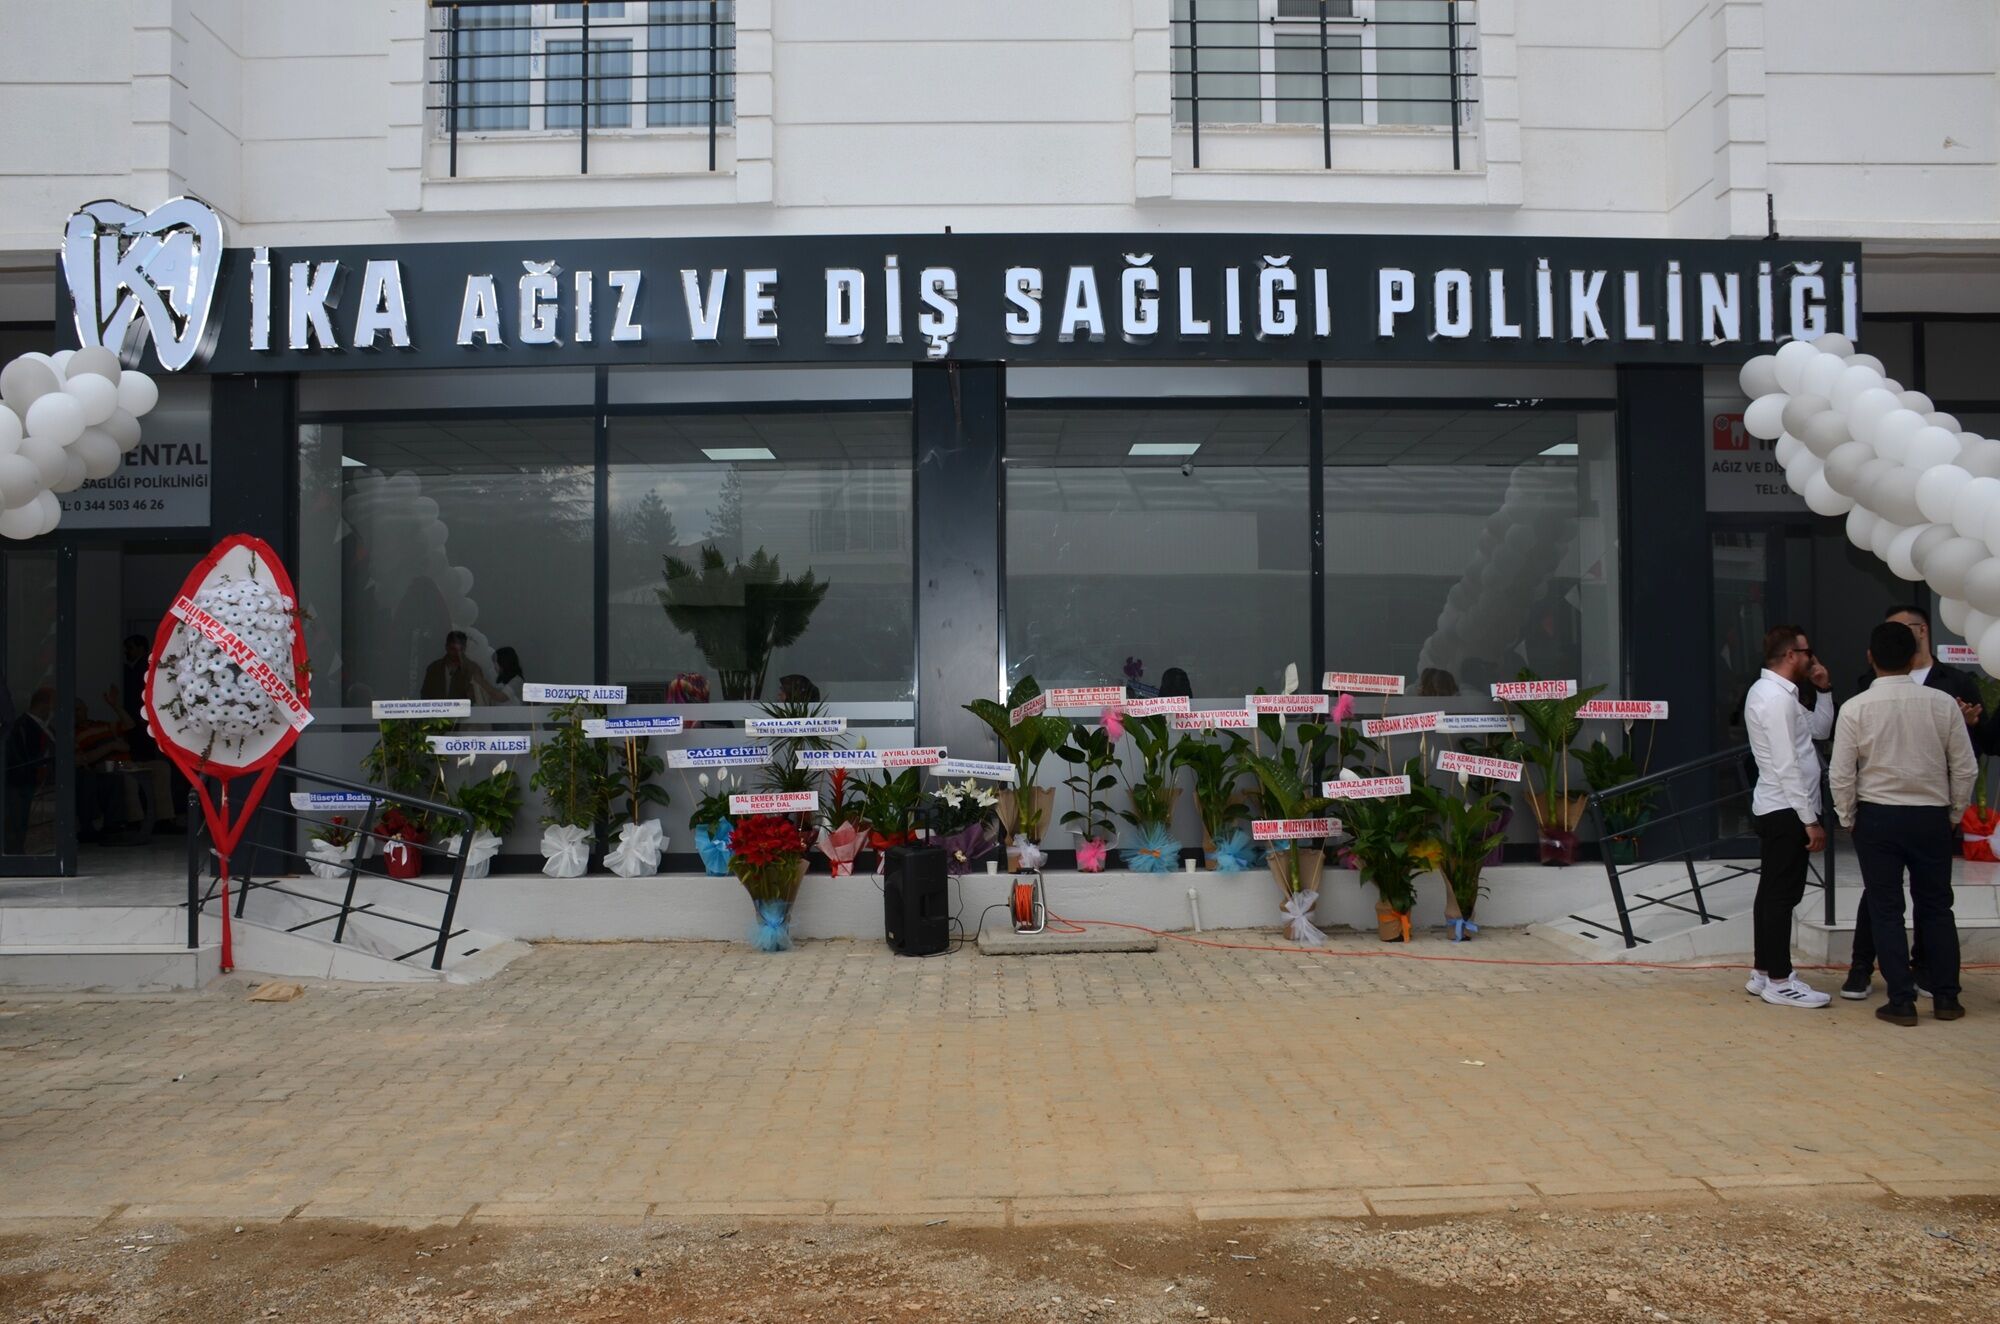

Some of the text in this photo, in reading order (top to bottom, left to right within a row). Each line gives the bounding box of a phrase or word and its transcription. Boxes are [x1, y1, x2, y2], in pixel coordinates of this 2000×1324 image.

[249, 246, 1859, 358] İKA AĞIZ VE DİŞ SAĞLIĞI POLİKLİNİĞİ
[122, 443, 208, 466] ENTAL
[1745, 462, 1761, 473] VE
[134, 474, 208, 489] POLİKLİNİĞİ
[1755, 484, 1788, 495] TEL: 0
[74, 501, 81, 511] 0
[86, 501, 105, 511] 344
[109, 500, 130, 511] 503
[133, 500, 147, 510] 46
[150, 500, 165, 510] 26
[184, 614, 283, 705] HASAN BOZ
[544, 687, 624, 699] BOZKURT AİLESİ
[1496, 682, 1527, 694] ZAFER
[1589, 701, 1613, 712] FARUK
[445, 739, 527, 751] GÖRÜR AİLESİ
[687, 746, 767, 758] ÇAĞRI GİYİM
[803, 750, 878, 759] MOR DENTAL
[1483, 767, 1518, 779] OLSUN
[1374, 777, 1404, 786] PETROL
[346, 793, 372, 801] Bozku
[735, 793, 812, 803] DAL EKMEK FABRİKASI
